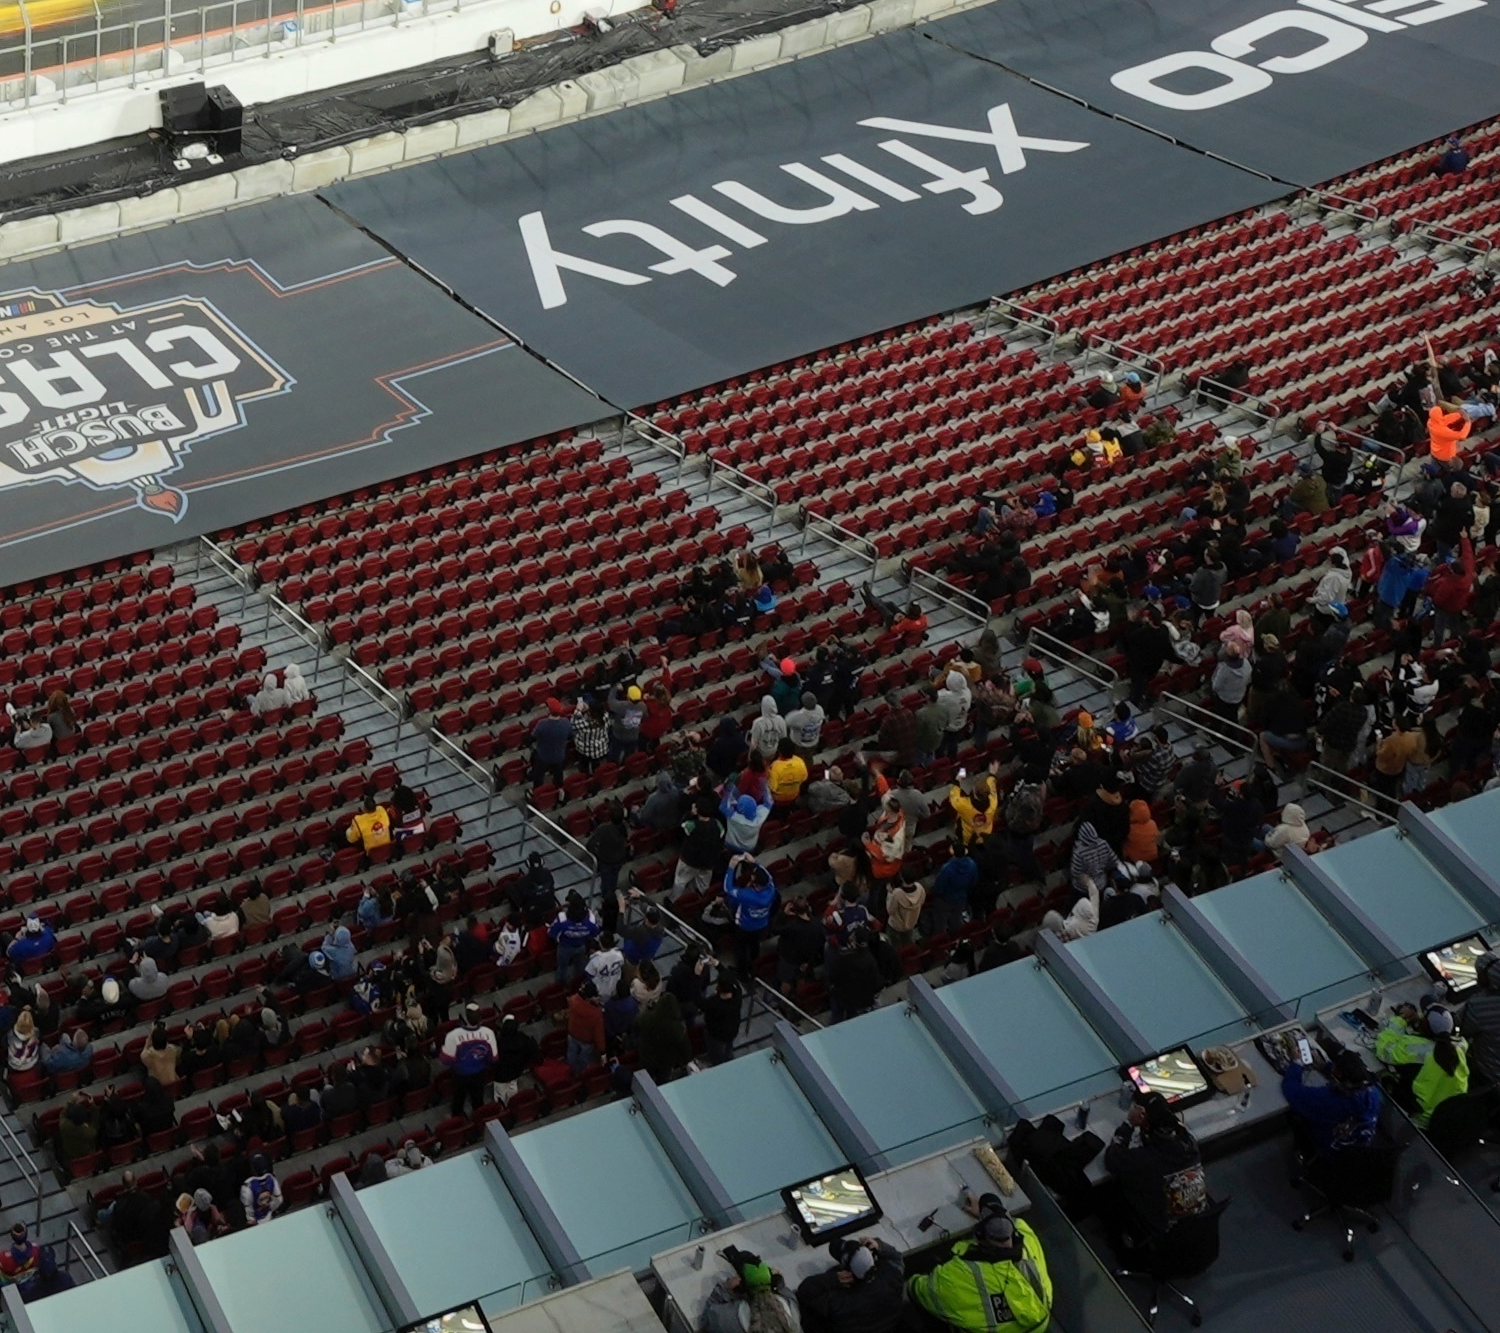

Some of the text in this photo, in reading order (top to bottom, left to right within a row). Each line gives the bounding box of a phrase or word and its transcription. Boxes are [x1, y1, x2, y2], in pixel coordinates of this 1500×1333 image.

[516, 102, 1091, 310] xfinity
[45, 310, 91, 328] LOS
[110, 319, 136, 336] AT
[45, 328, 99, 348] THE
[46, 402, 129, 429] LIGHT
[5, 402, 186, 470] BUSCH
[600, 961, 620, 977] 42
